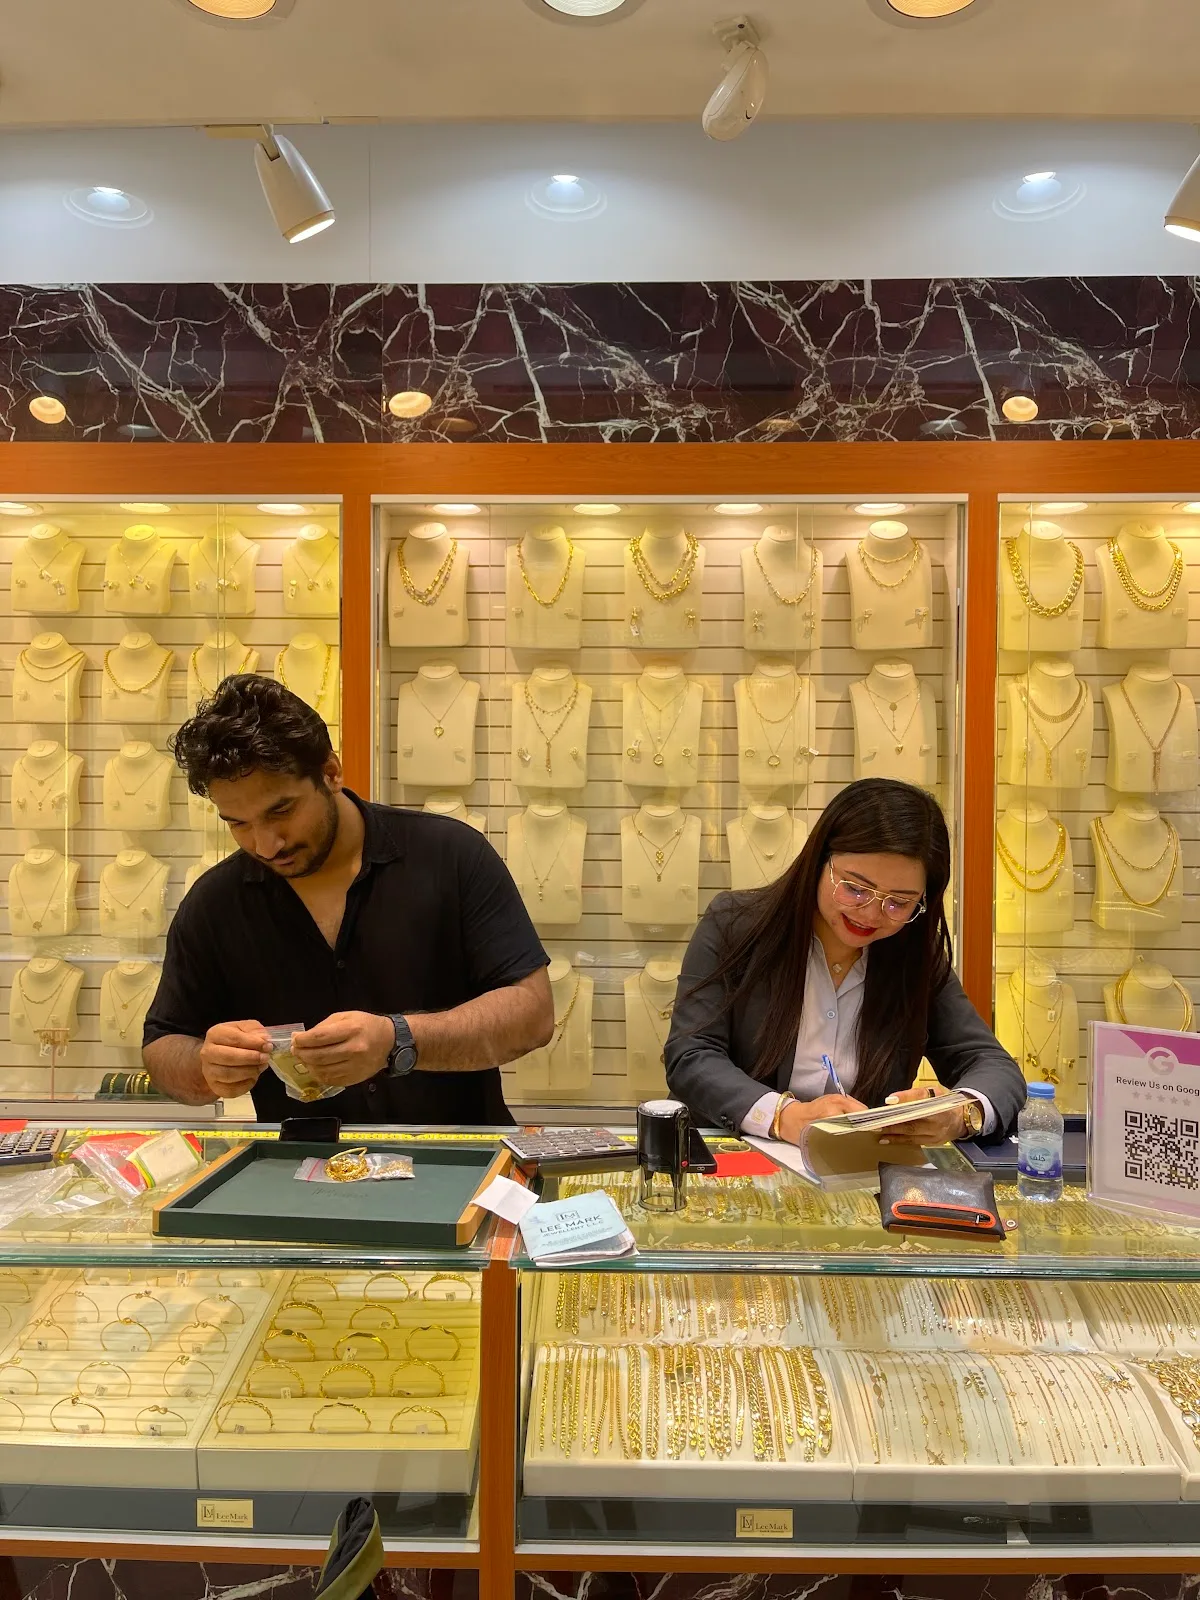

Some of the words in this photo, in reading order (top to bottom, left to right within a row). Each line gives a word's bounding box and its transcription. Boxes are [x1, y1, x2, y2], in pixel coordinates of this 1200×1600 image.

[1116, 1076, 1147, 1087] Review
[1149, 1080, 1160, 1089] Us
[1162, 1084, 1174, 1092] on
[1176, 1084, 1200, 1097] Goog
[540, 1224, 562, 1233] LEE
[565, 1215, 602, 1228] MARK
[542, 1225, 584, 1237] JEWELLERY
